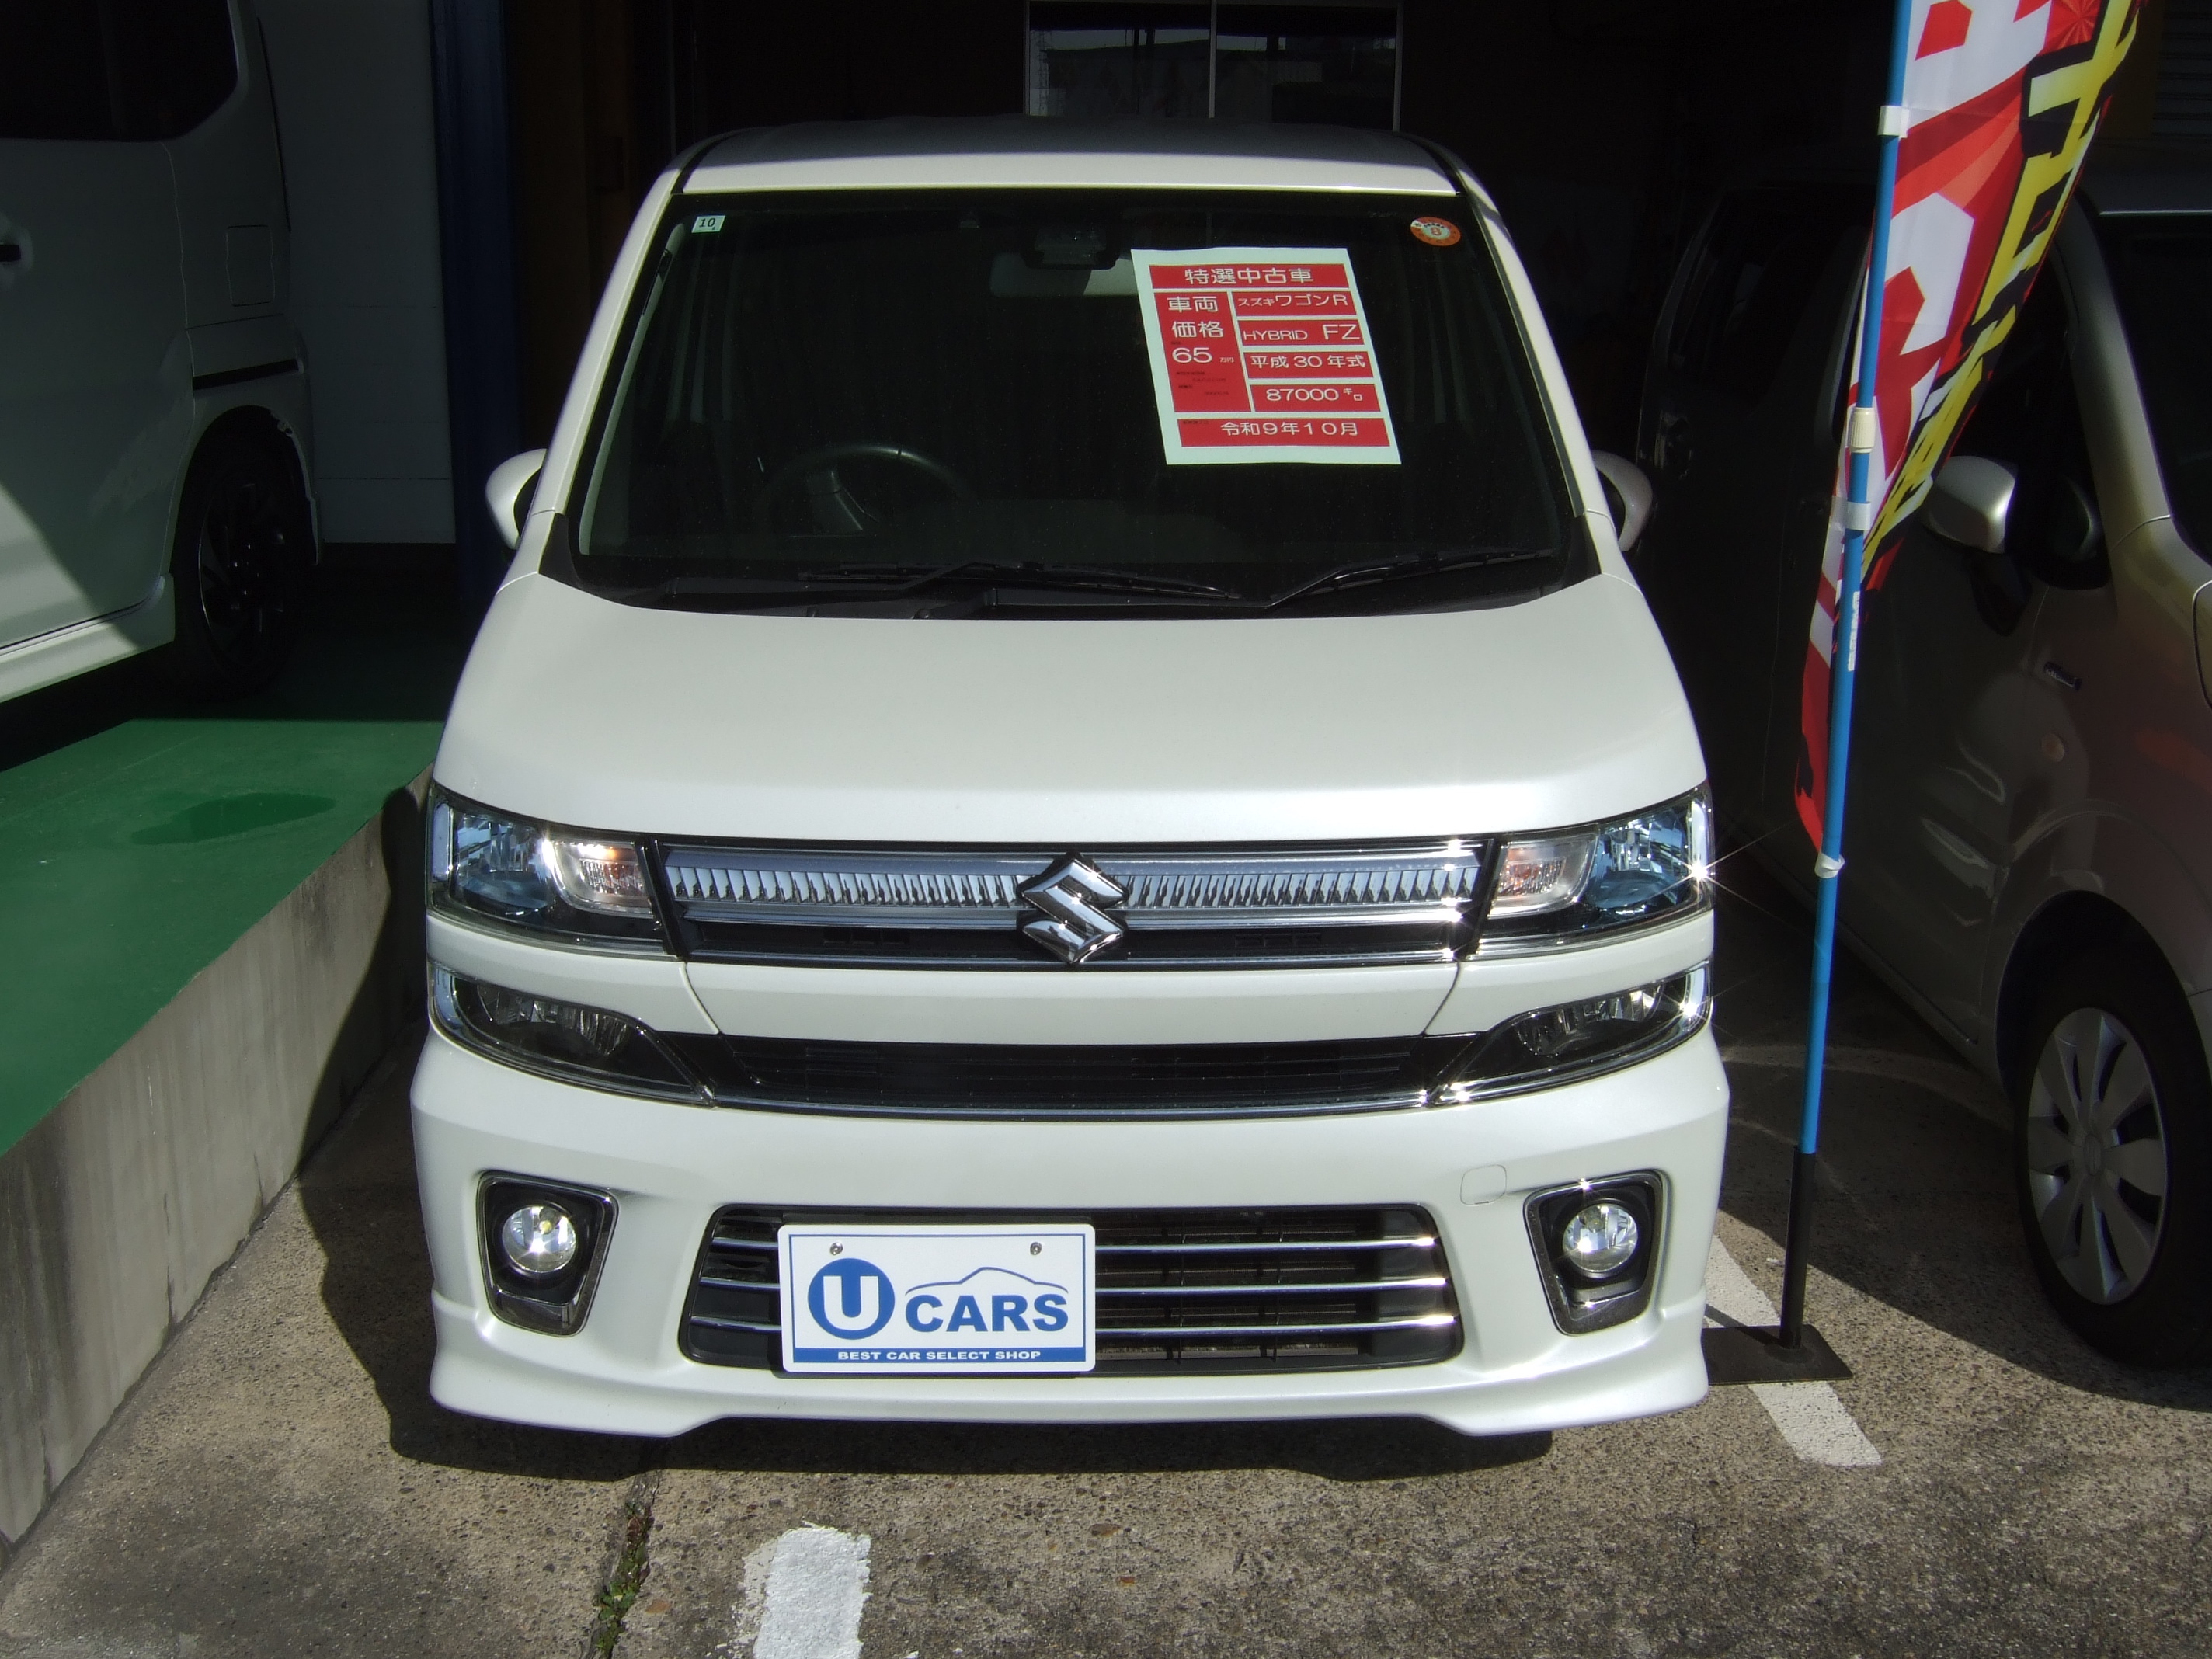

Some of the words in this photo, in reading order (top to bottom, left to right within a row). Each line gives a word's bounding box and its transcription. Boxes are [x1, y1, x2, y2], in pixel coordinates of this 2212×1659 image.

[699, 217, 716, 228] 10
[1184, 267, 1314, 285] 特選中古車
[1167, 296, 1219, 313] 車両
[1171, 321, 1224, 339] 価格
[1243, 330, 1308, 341] HYBRID
[1322, 324, 1360, 340] FZ
[1172, 347, 1213, 364] 65
[1266, 388, 1339, 402] 87000
[823, 1275, 880, 1331] U
[905, 1293, 1069, 1333] CARS
[838, 1351, 882, 1361] BEST
[885, 1351, 921, 1361] CAR
[925, 1351, 990, 1361] SELECT
[995, 1351, 1041, 1360] SHOP
